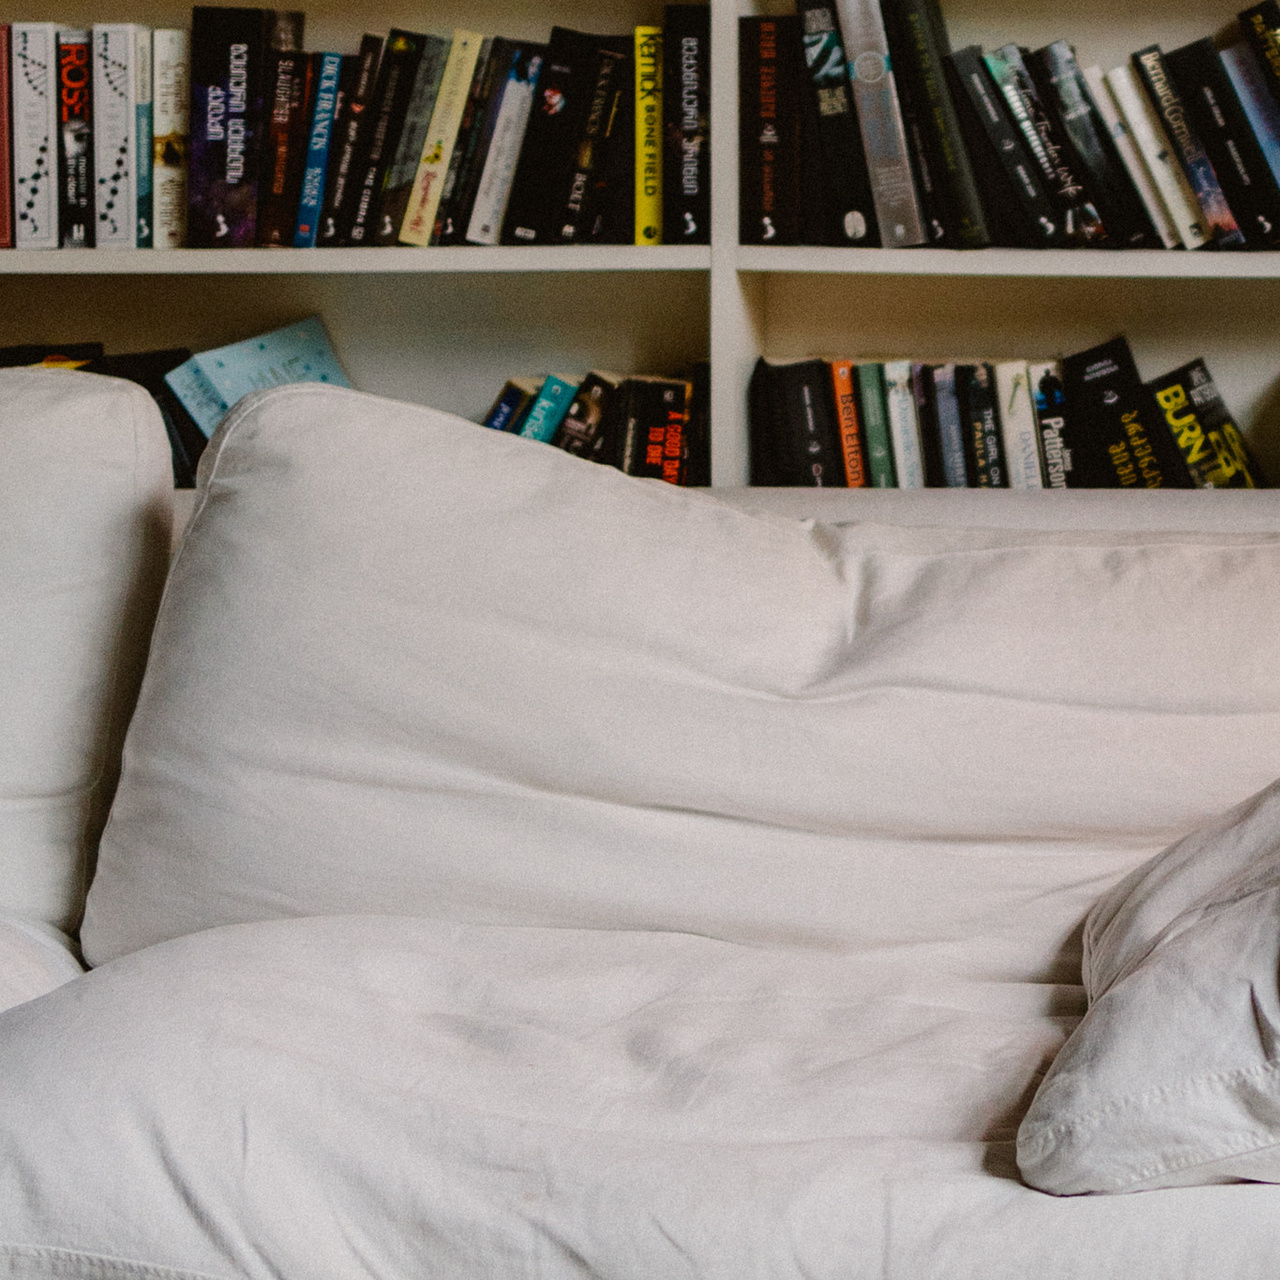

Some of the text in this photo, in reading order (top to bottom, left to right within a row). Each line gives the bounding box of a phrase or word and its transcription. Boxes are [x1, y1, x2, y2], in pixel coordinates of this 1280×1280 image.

[61, 43, 89, 122] ROSE
[272, 60, 294, 124] SLAUGHTER
[311, 55, 340, 151] DICK FRANCIS
[1140, 52, 1204, 163] Bernard Cornwell
[644, 105, 656, 147] BONE
[567, 173, 587, 213] BOLT
[643, 154, 656, 195] FIELD
[840, 393, 862, 482] Ben Elton
[973, 423, 984, 466] PAULA
[983, 409, 1000, 485] THE GIRL ON
[1042, 416, 1067, 488] Patterson
